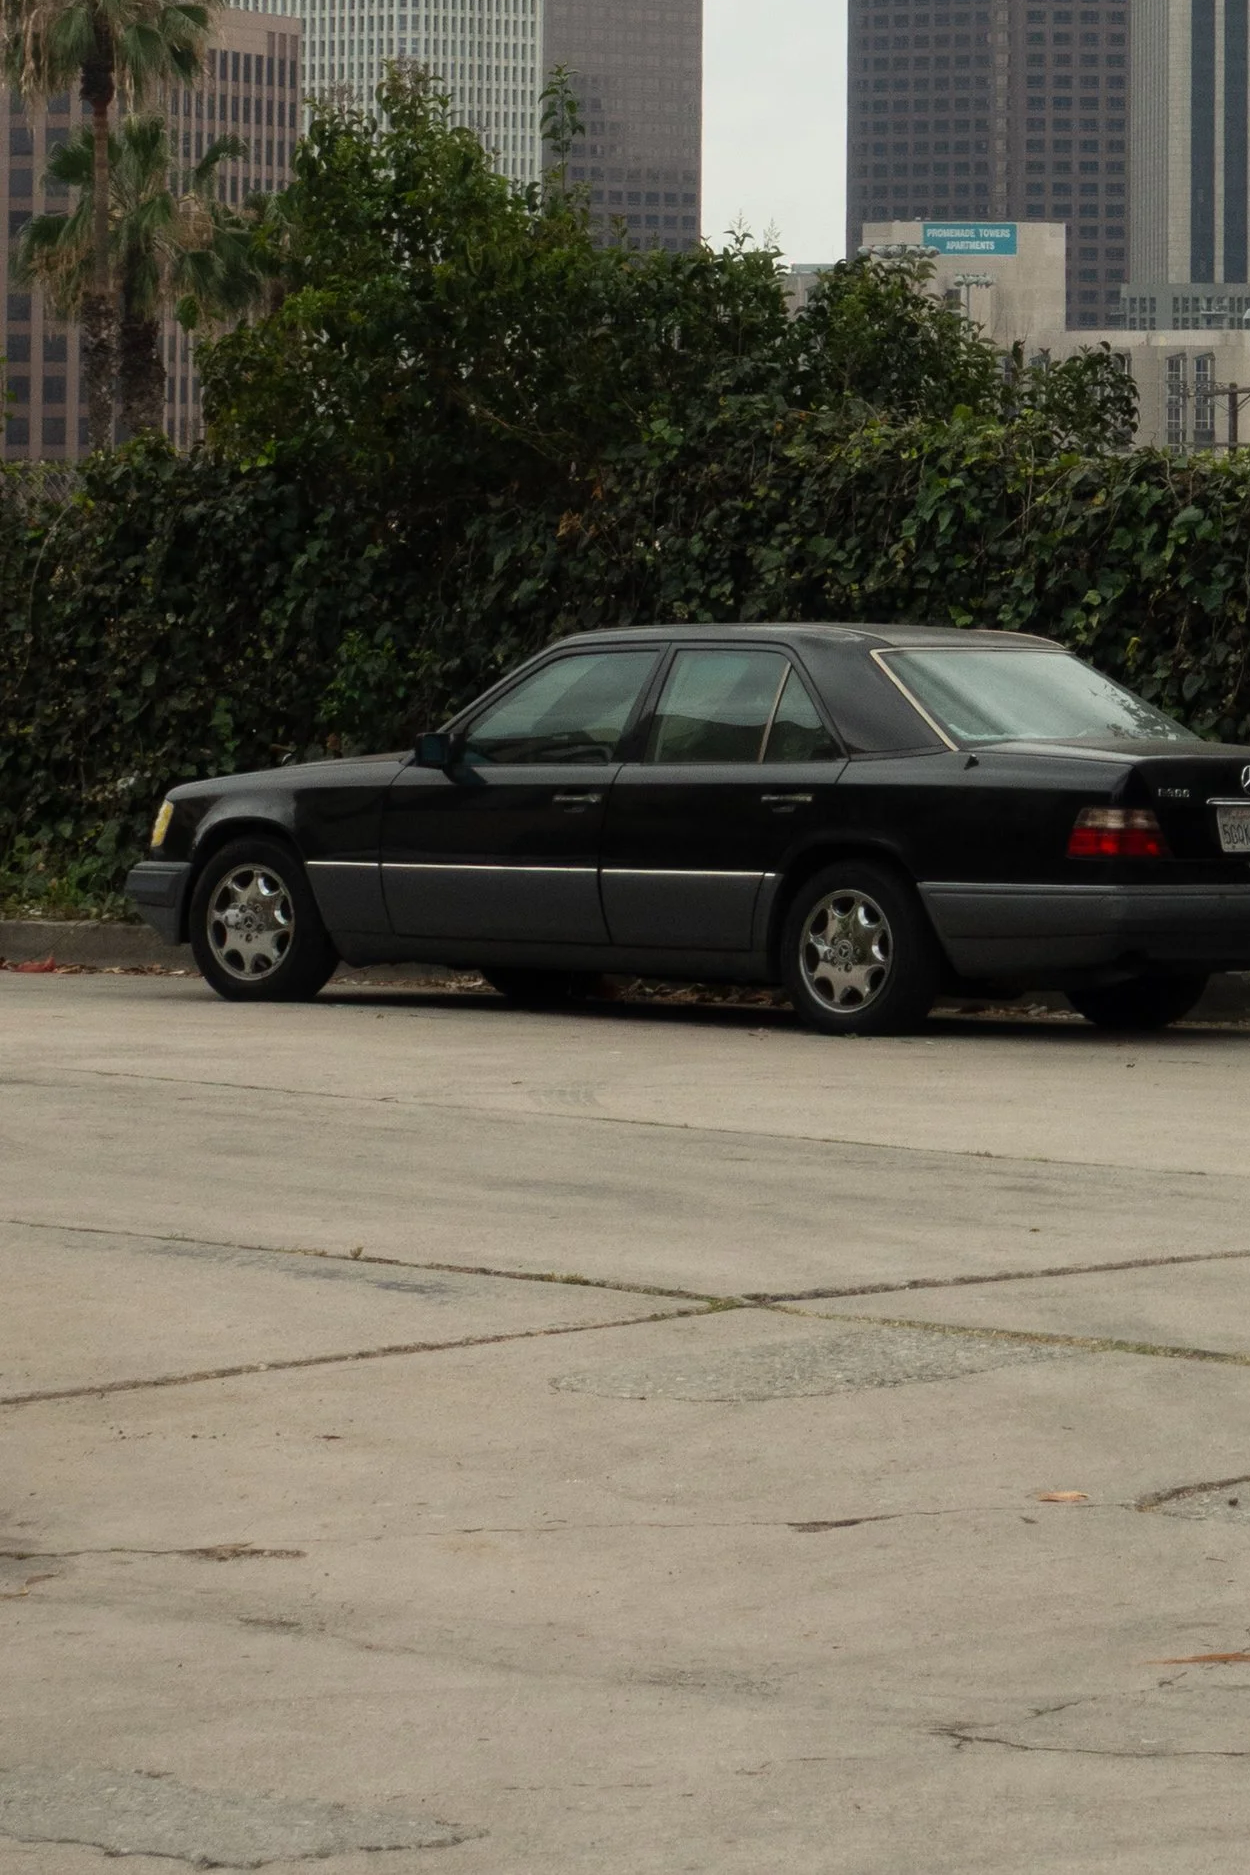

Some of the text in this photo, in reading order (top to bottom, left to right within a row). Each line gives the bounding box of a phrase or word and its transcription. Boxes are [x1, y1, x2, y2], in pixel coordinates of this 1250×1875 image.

[926, 228, 1011, 239] PROMENADE TOWERS
[946, 240, 995, 251] APARTMENTS
